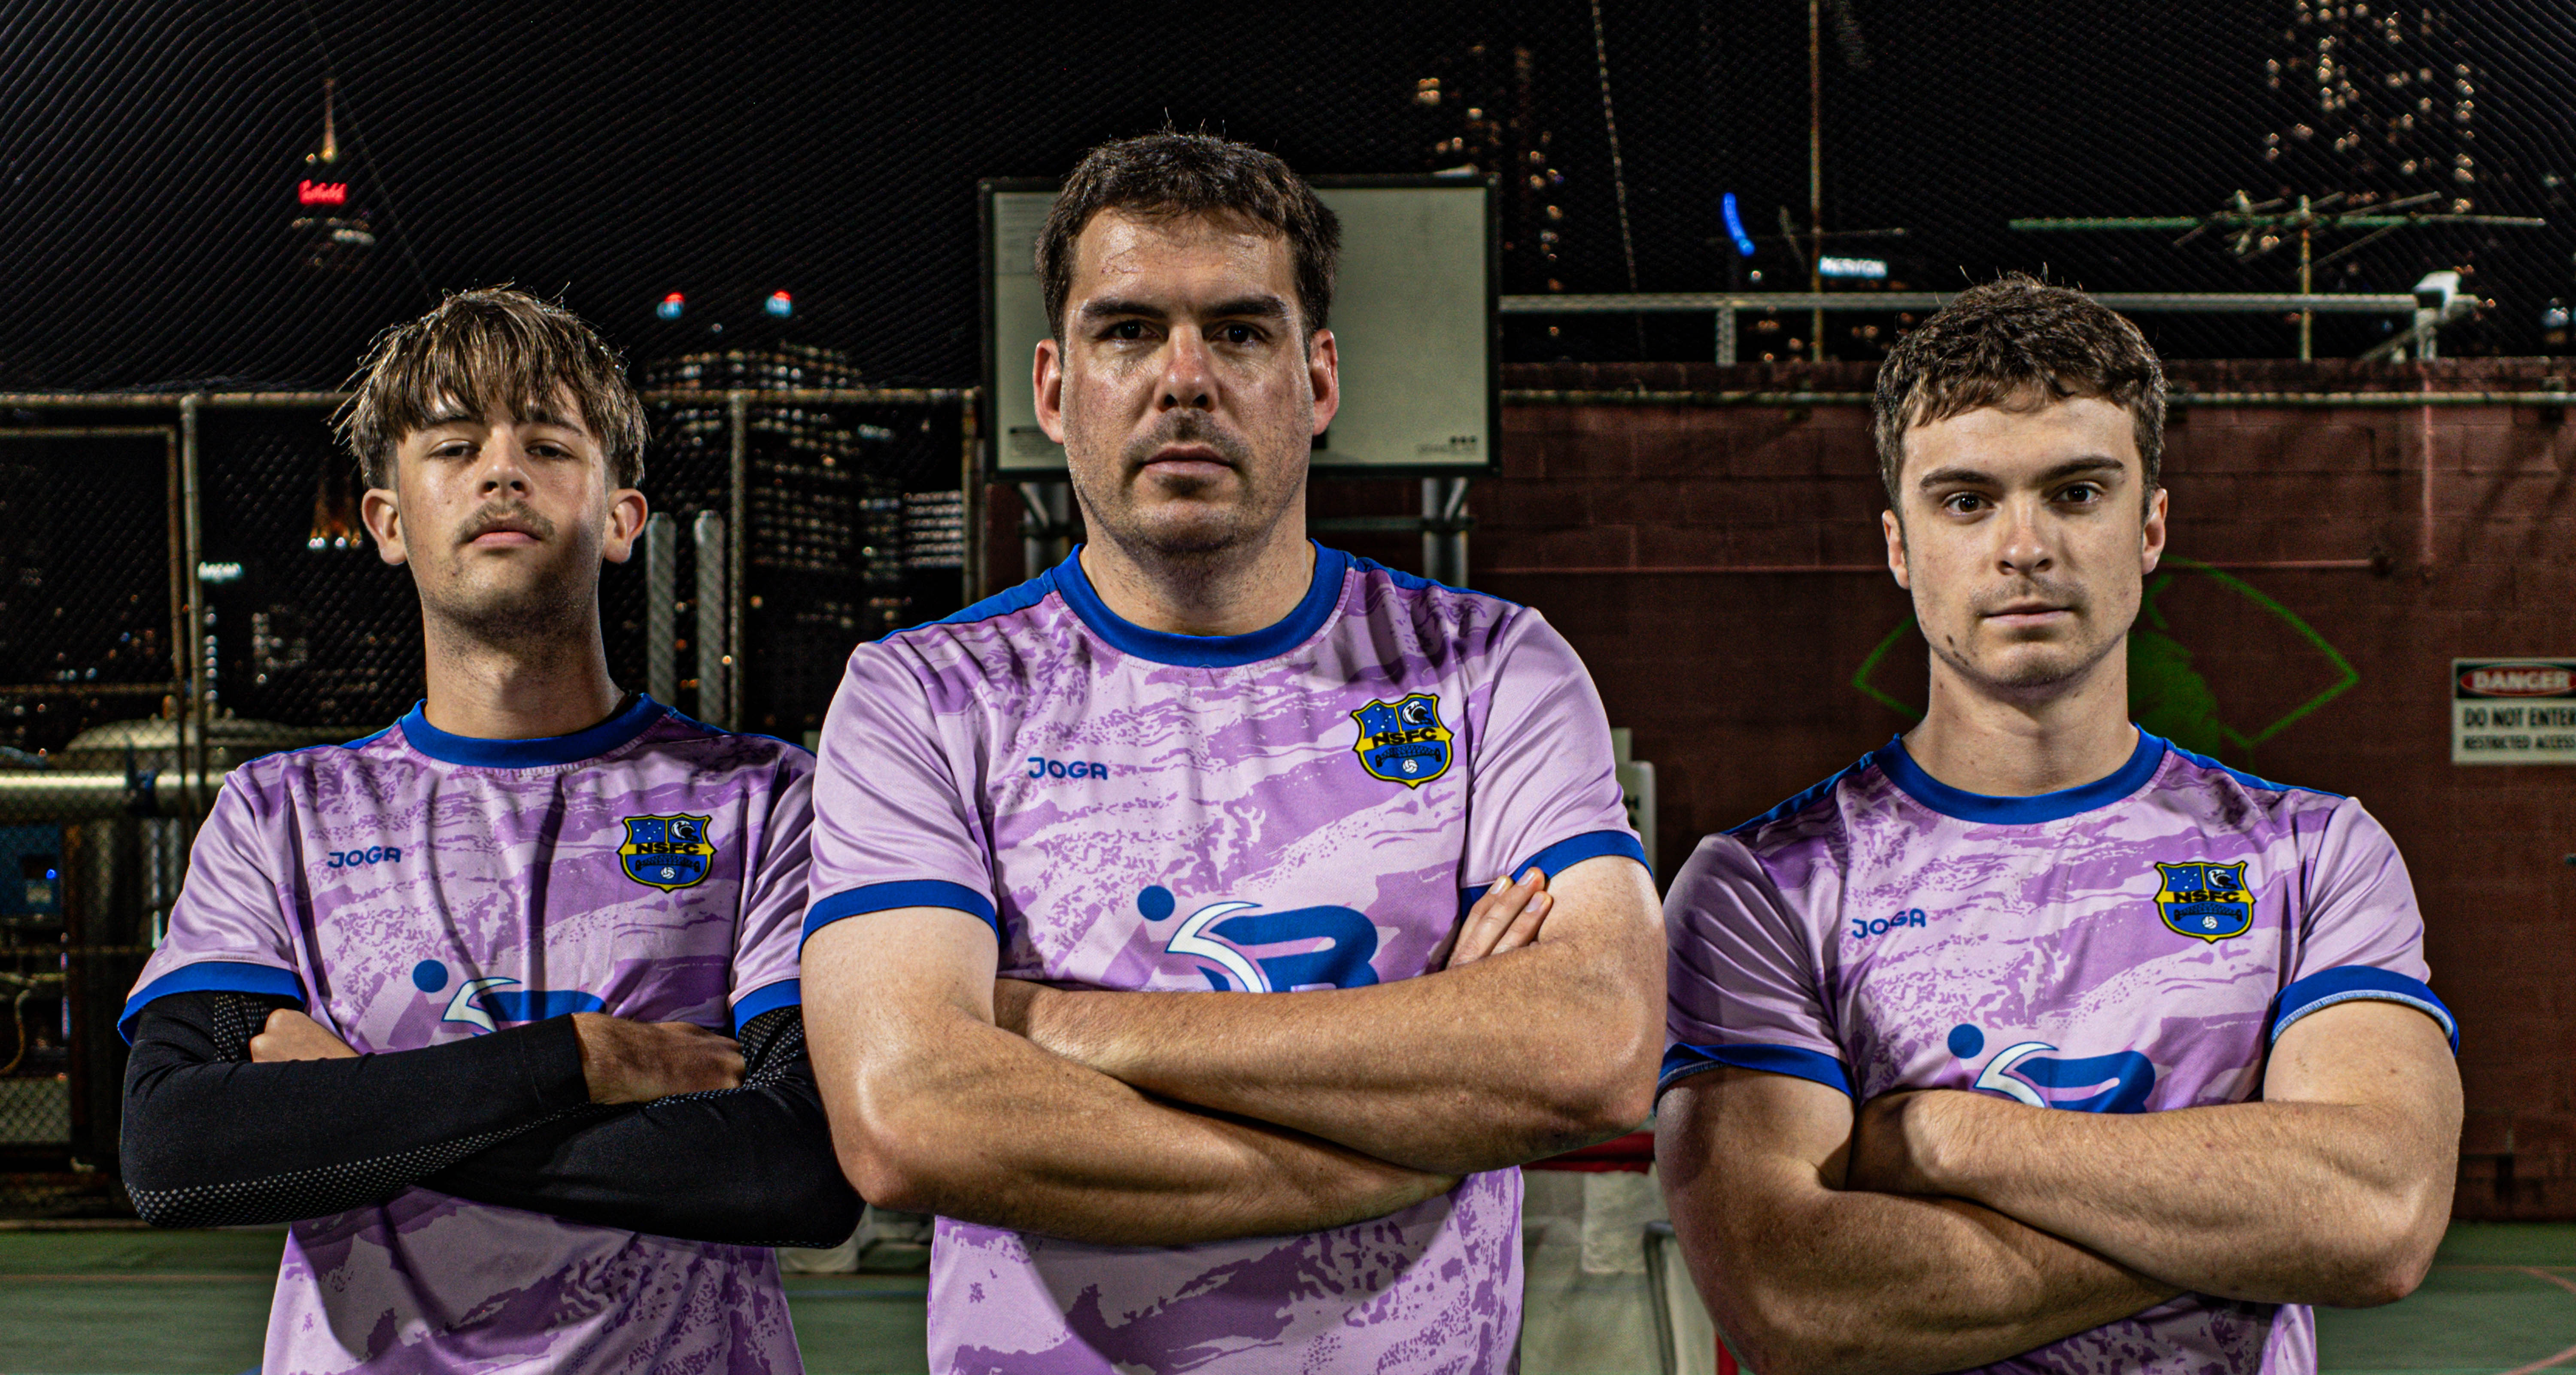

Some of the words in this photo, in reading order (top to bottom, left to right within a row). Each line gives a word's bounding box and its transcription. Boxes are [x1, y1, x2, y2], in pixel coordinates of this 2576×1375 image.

[2472, 671, 2570, 689] DANGER
[2464, 707, 2487, 726] DO
[2492, 707, 2522, 726] NOT
[1372, 728, 1437, 747] NSFC
[2464, 735, 2530, 749] RESTRICTED
[1027, 757, 1108, 780] JOGA
[327, 846, 401, 868] JOGA
[635, 842, 700, 855] NSFC
[2173, 890, 2240, 903] NSFC
[1852, 908, 1926, 939] JOGA
